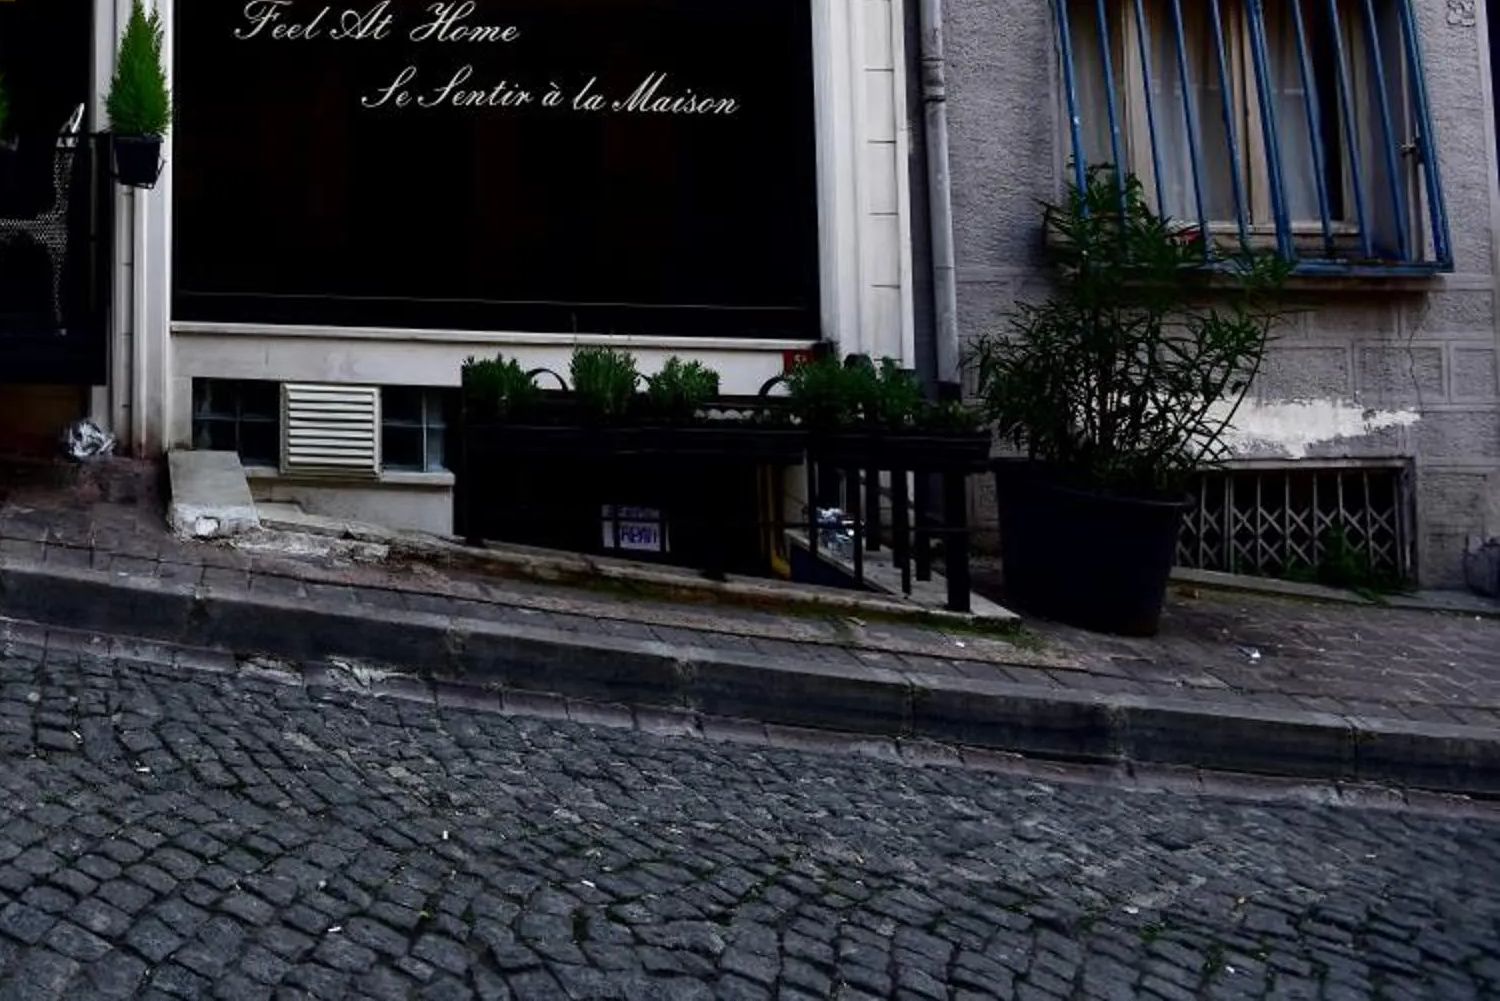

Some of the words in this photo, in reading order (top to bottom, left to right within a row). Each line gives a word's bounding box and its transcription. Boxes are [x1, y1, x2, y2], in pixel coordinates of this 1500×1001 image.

[409, 0, 521, 43] Home
[361, 65, 416, 109] Se
[417, 64, 535, 109] Sentir
[541, 81, 564, 109] à
[573, 75, 606, 111] la
[612, 71, 742, 115] Maison
